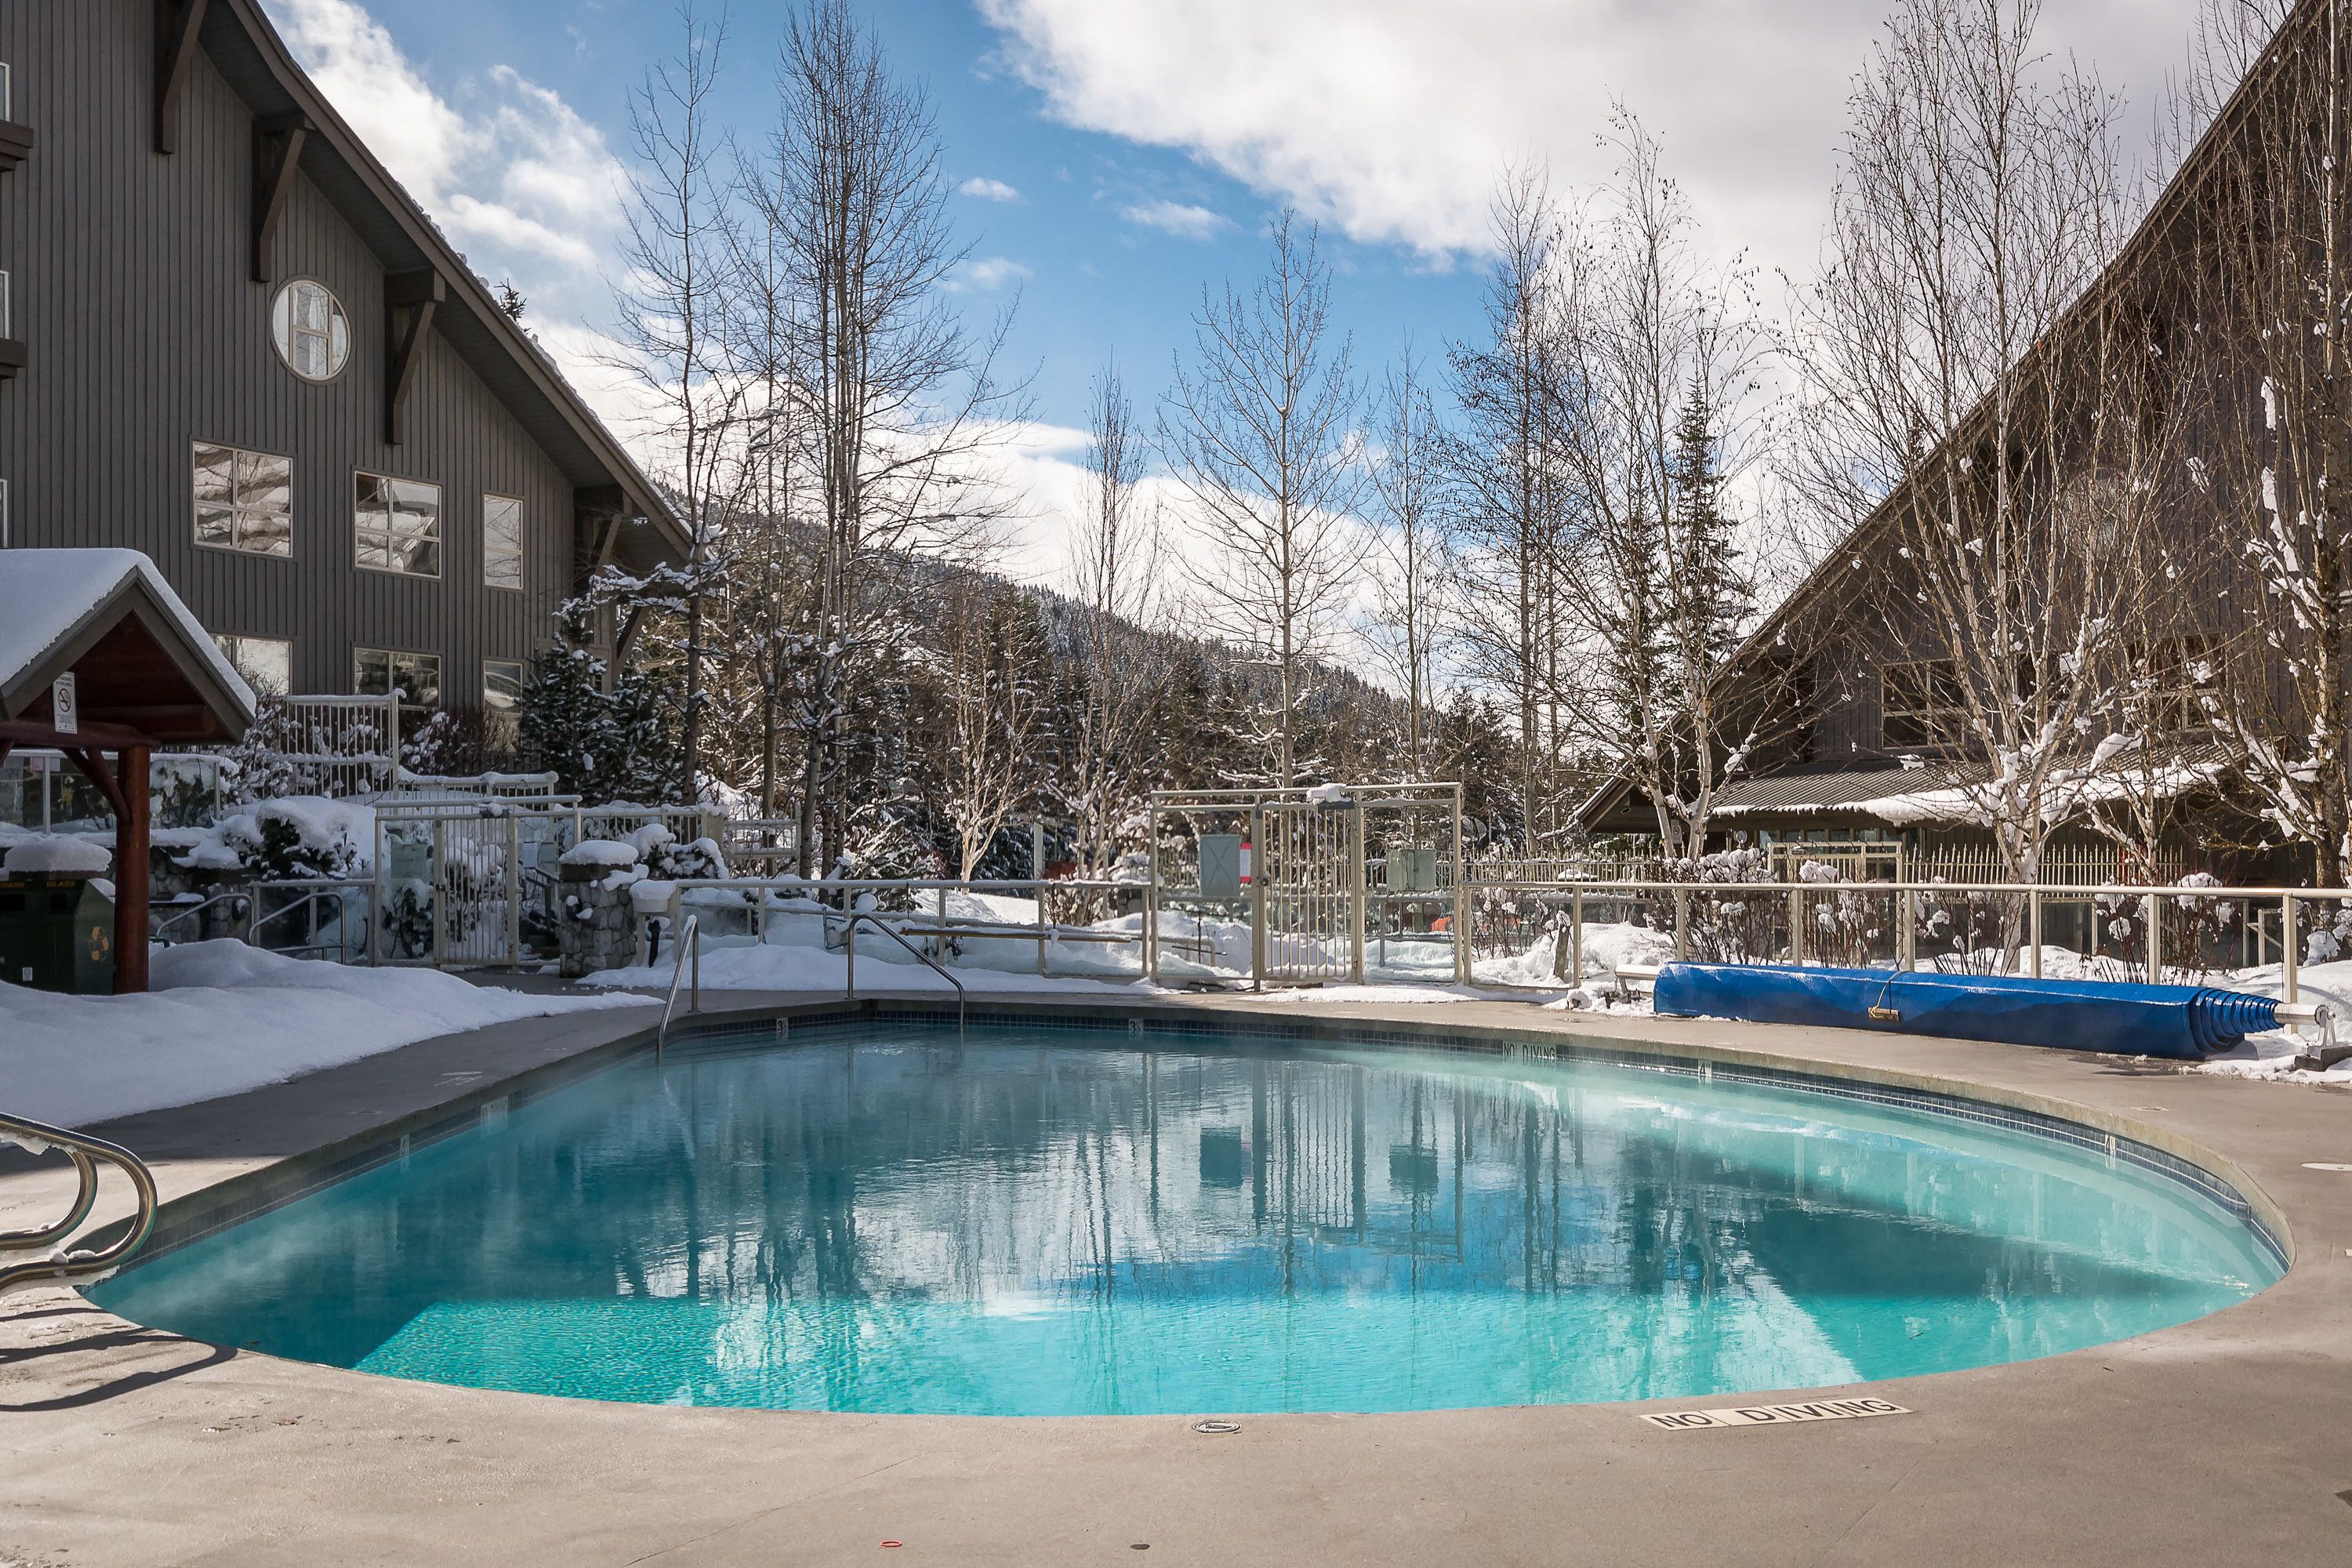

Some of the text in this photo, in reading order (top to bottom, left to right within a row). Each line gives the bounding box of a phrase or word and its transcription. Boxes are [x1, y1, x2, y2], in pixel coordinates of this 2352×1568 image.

[1504, 1043, 1555, 1059] NO DIVING
[1650, 1399, 1901, 1428] NO DIVING
